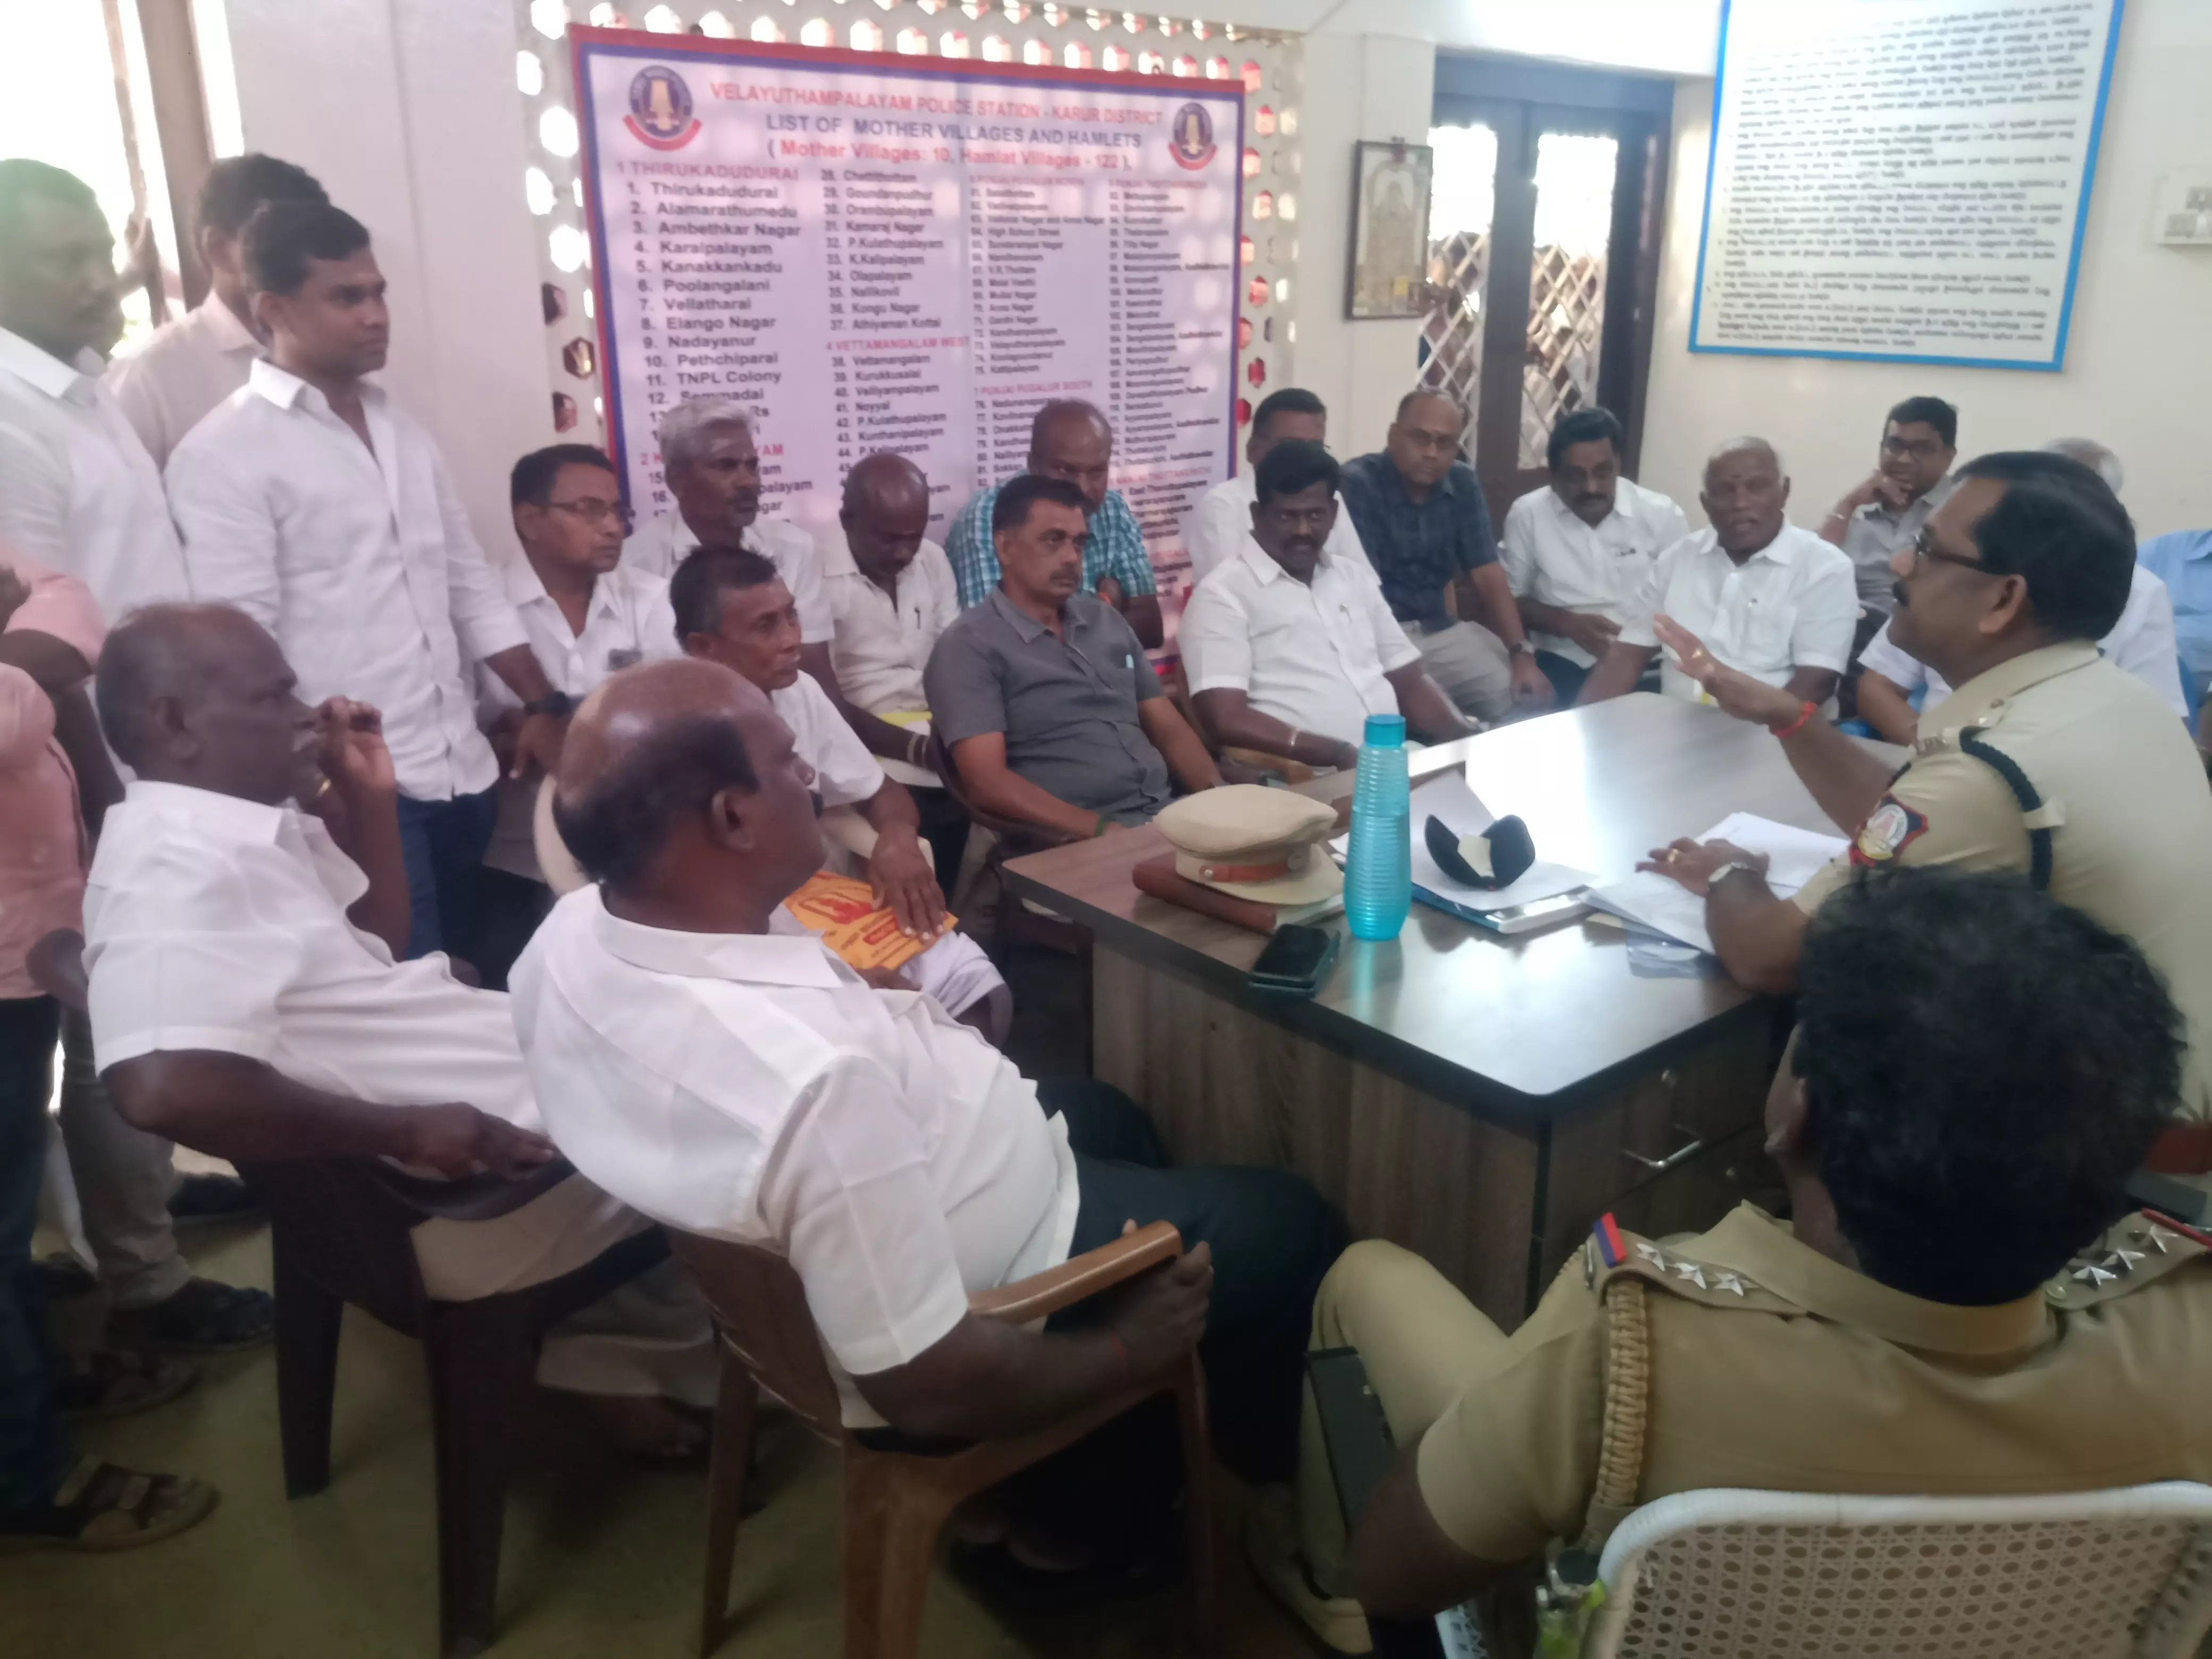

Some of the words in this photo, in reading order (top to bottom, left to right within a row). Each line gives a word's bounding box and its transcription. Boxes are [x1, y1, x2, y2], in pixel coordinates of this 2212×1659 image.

[709, 82, 914, 111] VELAYUTHAMPALAYAM
[917, 96, 973, 116] POLICE
[977, 100, 1041, 118] STATION
[1052, 105, 1100, 122] KARUR
[1104, 107, 1163, 125] DISTRICT
[765, 113, 809, 132] LIST
[815, 116, 842, 133] OF
[853, 118, 934, 138] MOTHER
[937, 124, 1024, 143] VILLAGES
[1029, 129, 1063, 144] AND
[1068, 131, 1142, 148] HAMLETS
[780, 139, 845, 158] Mother
[1021, 151, 1080, 169] Villages
[627, 182, 641, 195] 1.
[630, 201, 646, 214] 2.
[633, 221, 648, 234] 3.
[754, 223, 802, 239] Nagar
[634, 240, 649, 254] 4.
[636, 259, 652, 273] 5.
[639, 298, 655, 312] 7.
[666, 317, 724, 331] Elango
[728, 316, 776, 331] Nagar
[642, 336, 658, 349] 9.
[668, 336, 757, 350] Nadayanur
[644, 355, 667, 368] 10.
[646, 374, 667, 386] 11.
[676, 372, 722, 385] TNPL
[725, 371, 782, 384] Colony
[648, 392, 670, 405] 12.
